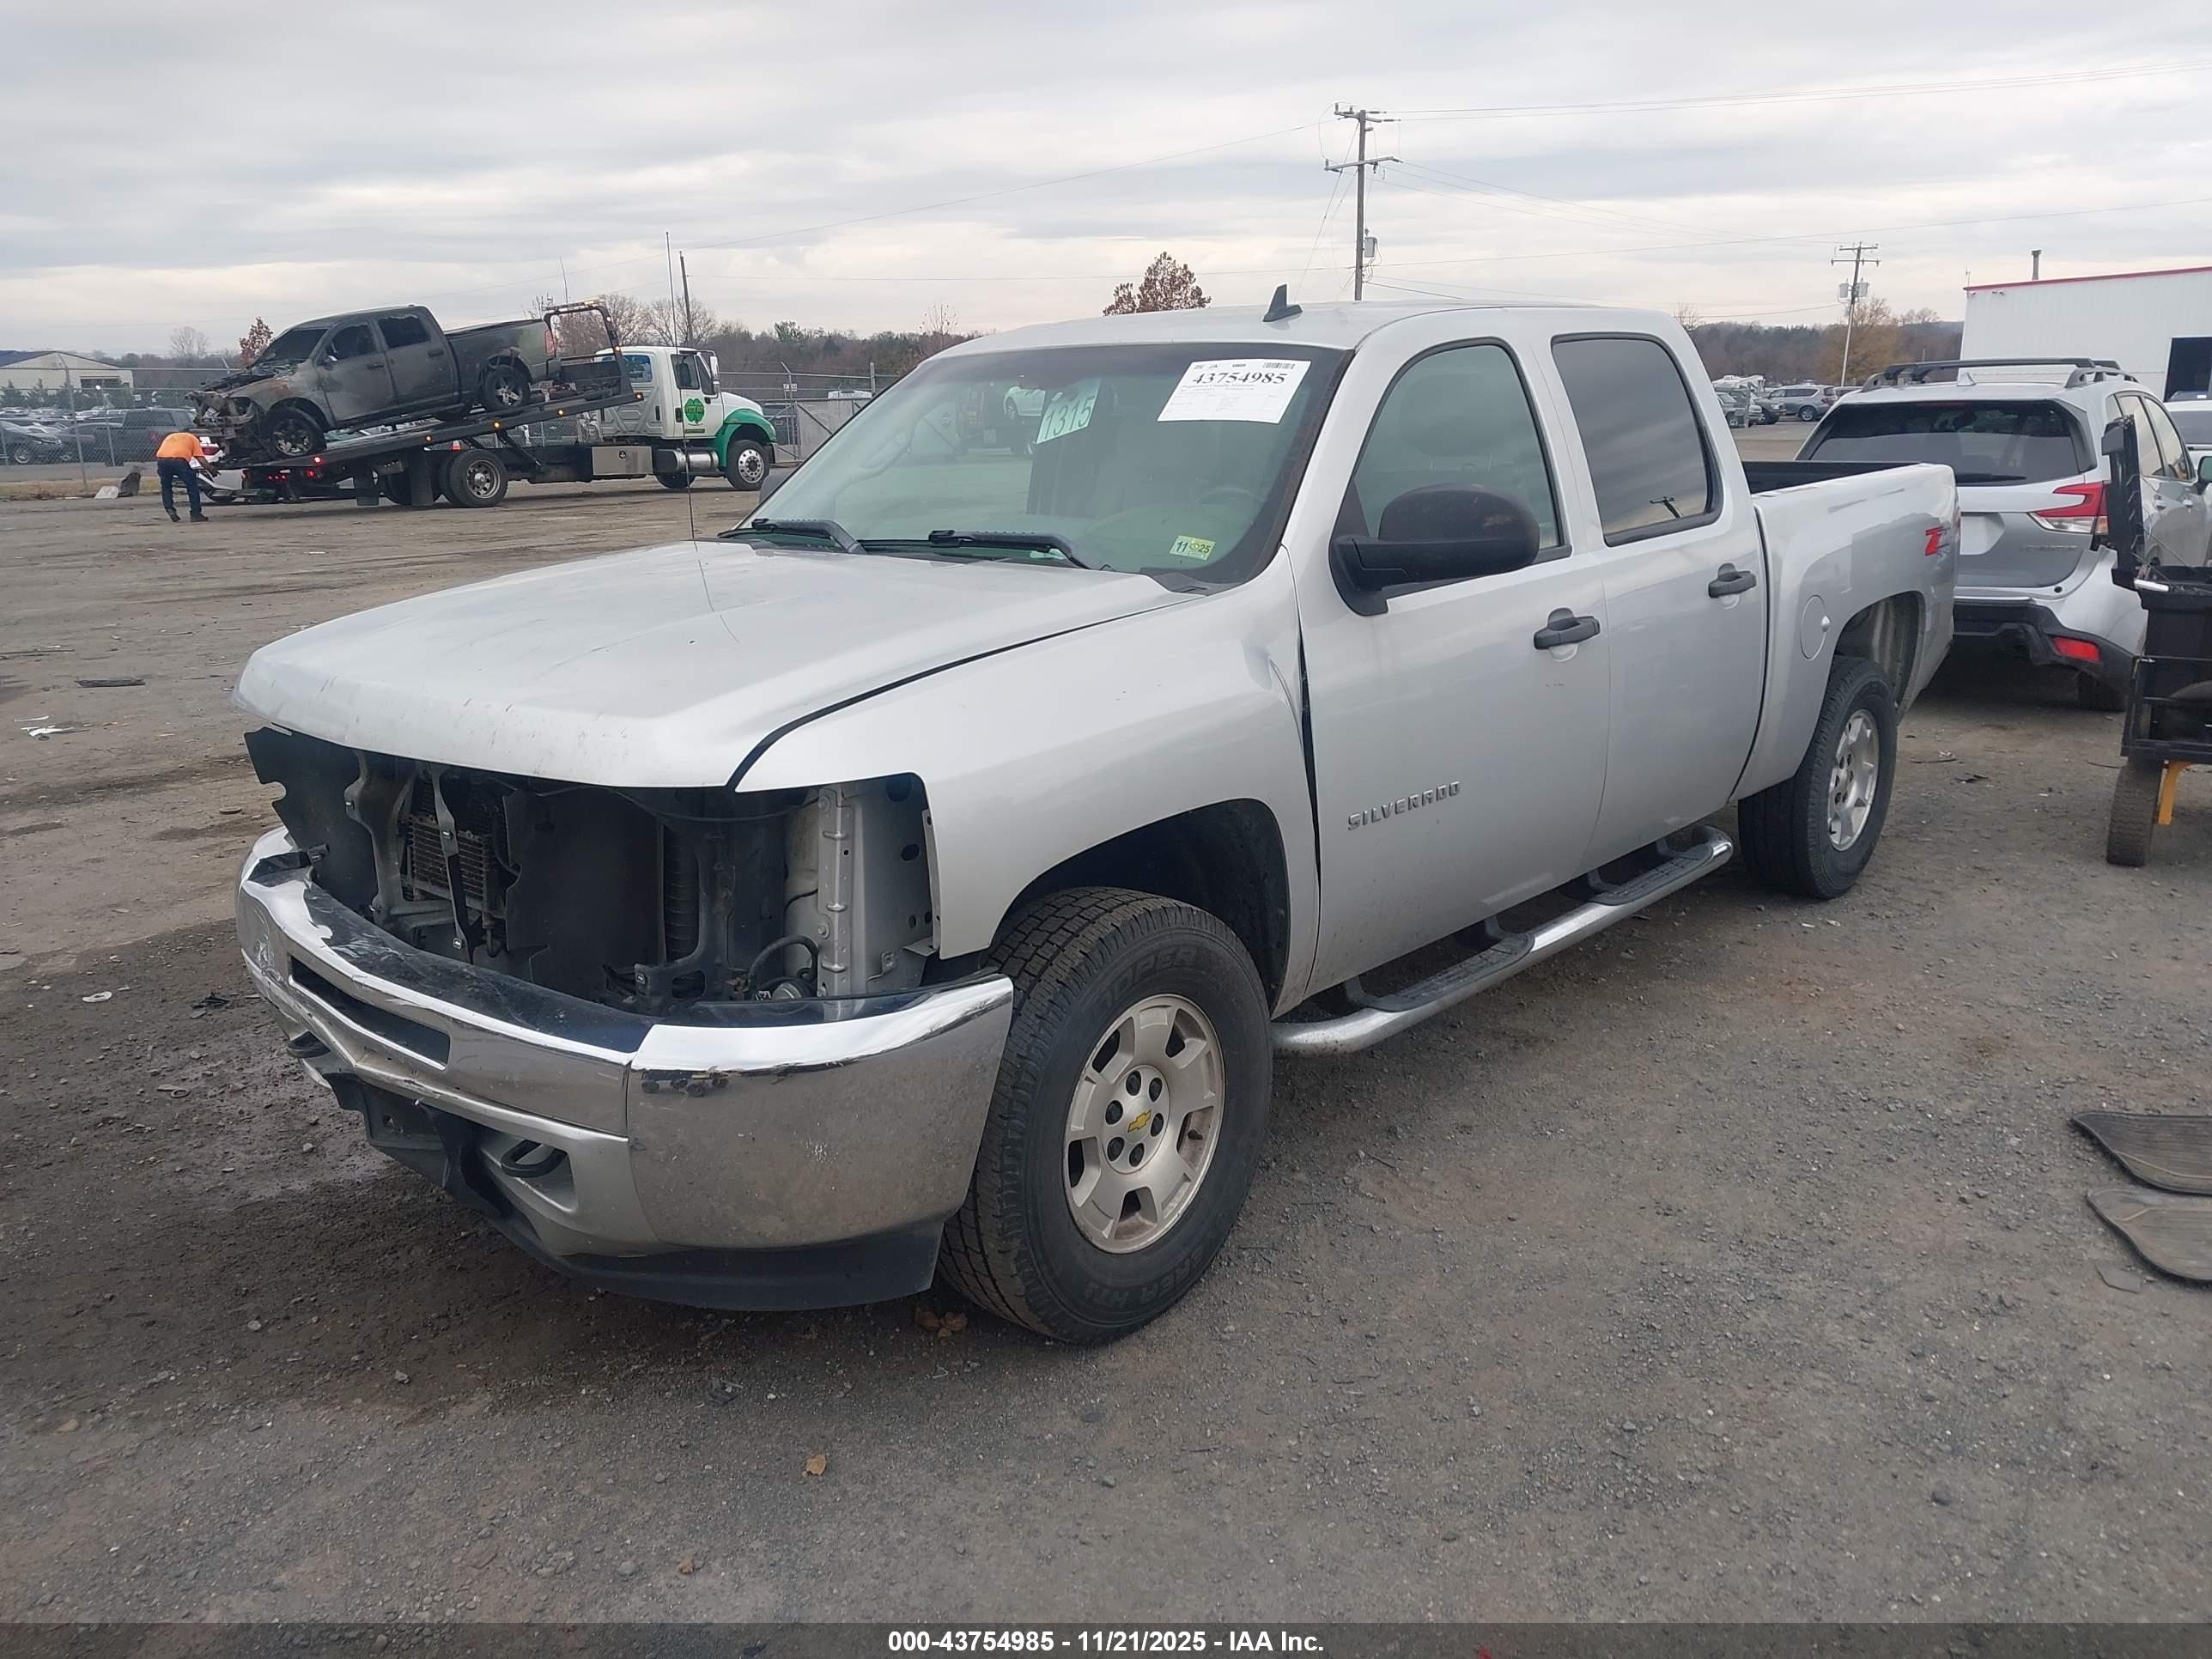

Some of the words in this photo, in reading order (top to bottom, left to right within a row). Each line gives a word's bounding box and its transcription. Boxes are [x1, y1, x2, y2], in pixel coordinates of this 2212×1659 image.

[1192, 371, 1288, 385] 43754985
[1044, 395, 1095, 441] 1315
[1176, 541, 1188, 553] 11
[1197, 544, 1211, 555] 25
[1346, 781, 1462, 831] SILVERADO
